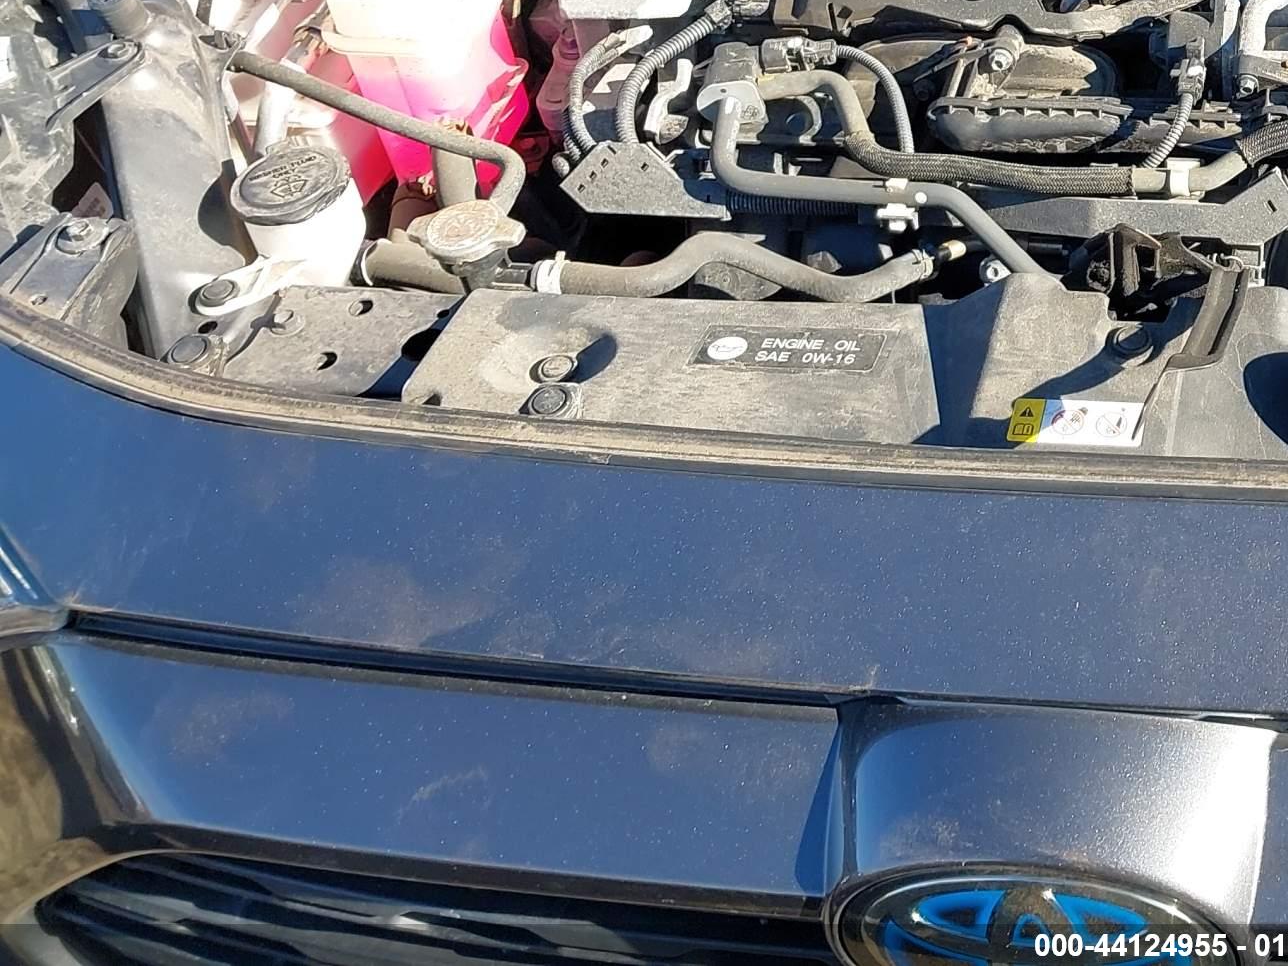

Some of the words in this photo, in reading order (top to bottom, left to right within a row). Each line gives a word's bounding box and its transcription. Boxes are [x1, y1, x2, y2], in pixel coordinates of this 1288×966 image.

[761, 337, 825, 351] ENGINE
[833, 339, 862, 352] OIL
[754, 350, 792, 363] SAE
[801, 352, 857, 365] 0W-16
